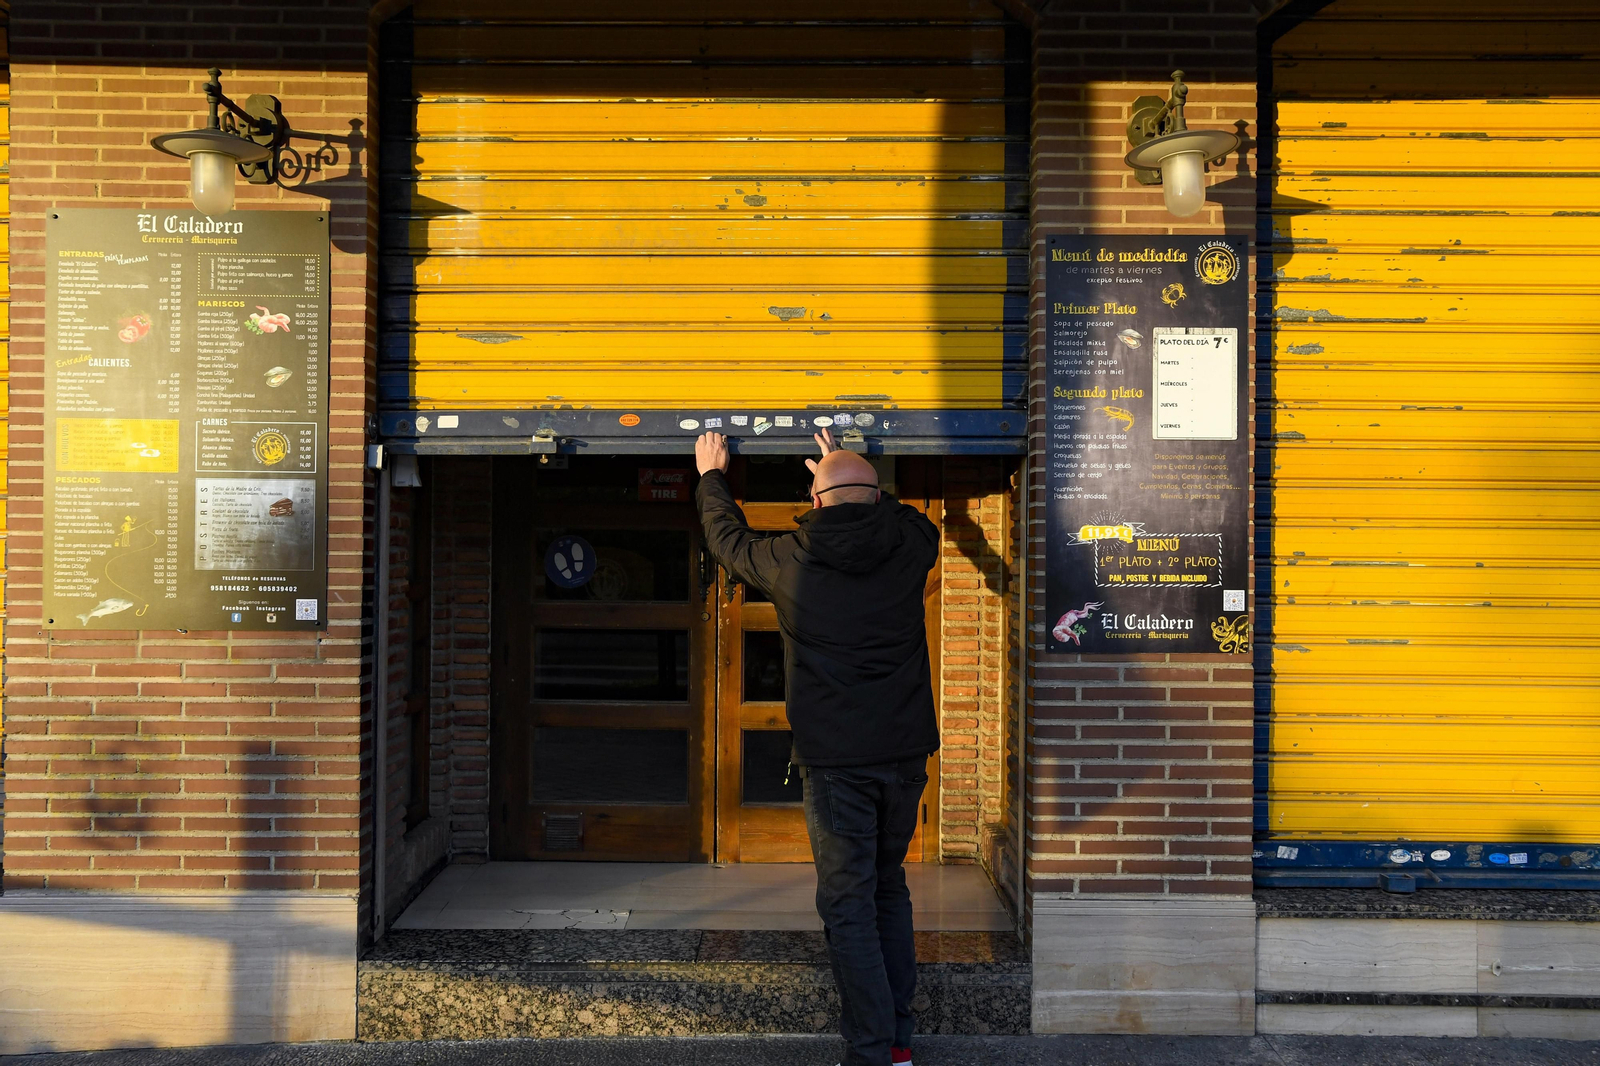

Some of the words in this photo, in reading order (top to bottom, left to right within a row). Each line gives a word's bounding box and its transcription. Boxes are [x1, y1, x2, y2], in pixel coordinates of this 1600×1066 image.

[137, 214, 157, 233] El
[164, 215, 243, 234] Caladero
[117, 255, 149, 265] TEMPLADAS
[1052, 248, 1092, 262] Menú
[1096, 248, 1114, 262] de
[1119, 247, 1188, 262] mediodía
[1127, 266, 1163, 274] viernes
[1054, 302, 1100, 314] Primer
[1104, 302, 1138, 314] Plato
[55, 354, 93, 368] Entradas
[88, 358, 132, 368] CALIENTES.
[1054, 386, 1108, 400] Segundo
[1112, 386, 1144, 400] plato
[651, 490, 677, 499] TIRE
[200, 487, 208, 561] POSTRES
[1087, 528, 1119, 538] 11,95
[1137, 536, 1180, 551] MENÚ
[1100, 555, 1114, 567] 1er
[1119, 556, 1152, 568] PLATO
[1185, 556, 1217, 568] PLATO
[1109, 574, 1124, 583] PAN,
[1101, 613, 1119, 629] El
[1124, 614, 1193, 630] Caladero
